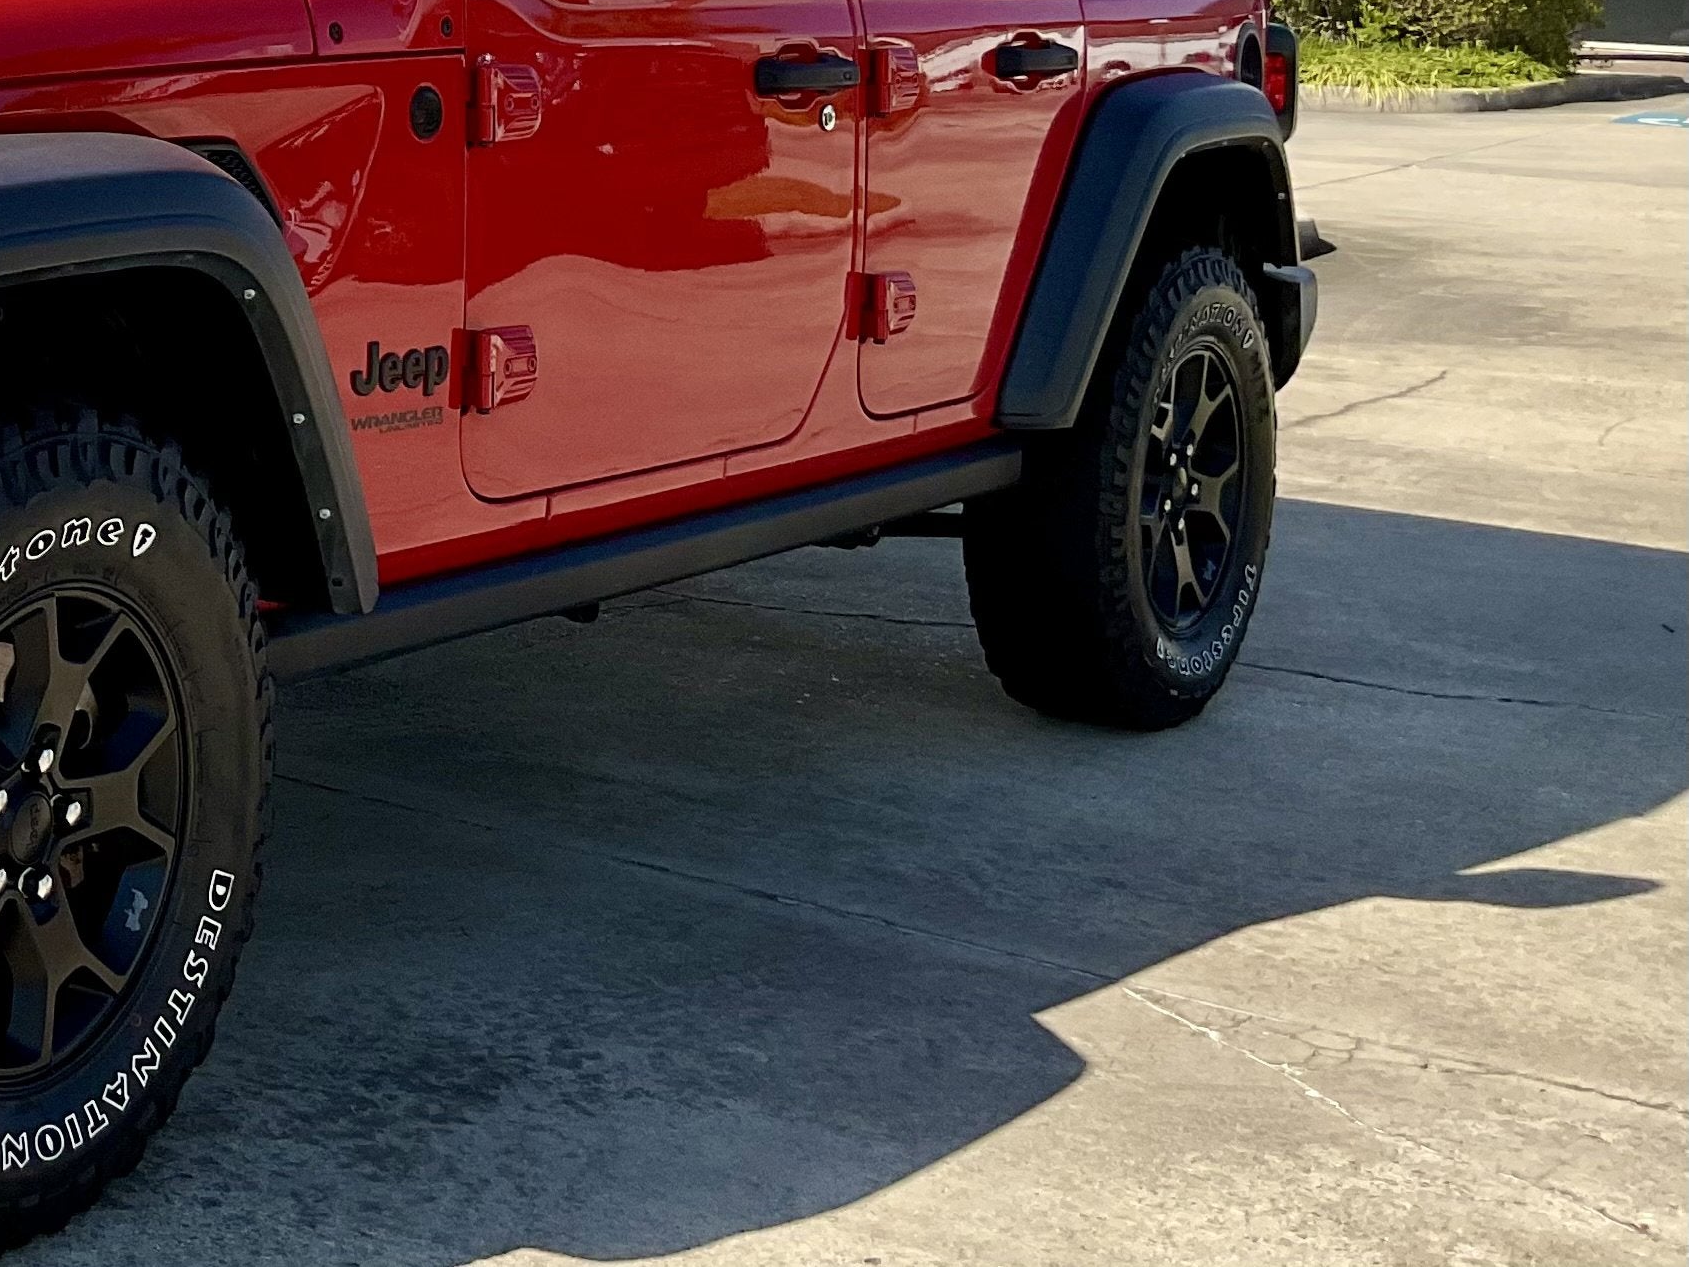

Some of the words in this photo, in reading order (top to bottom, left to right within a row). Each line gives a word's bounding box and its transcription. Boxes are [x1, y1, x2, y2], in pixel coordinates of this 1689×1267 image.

[350, 340, 449, 396] Jeep
[351, 406, 444, 431] WRANGLER
[1, 869, 235, 1171] DESTINATION
